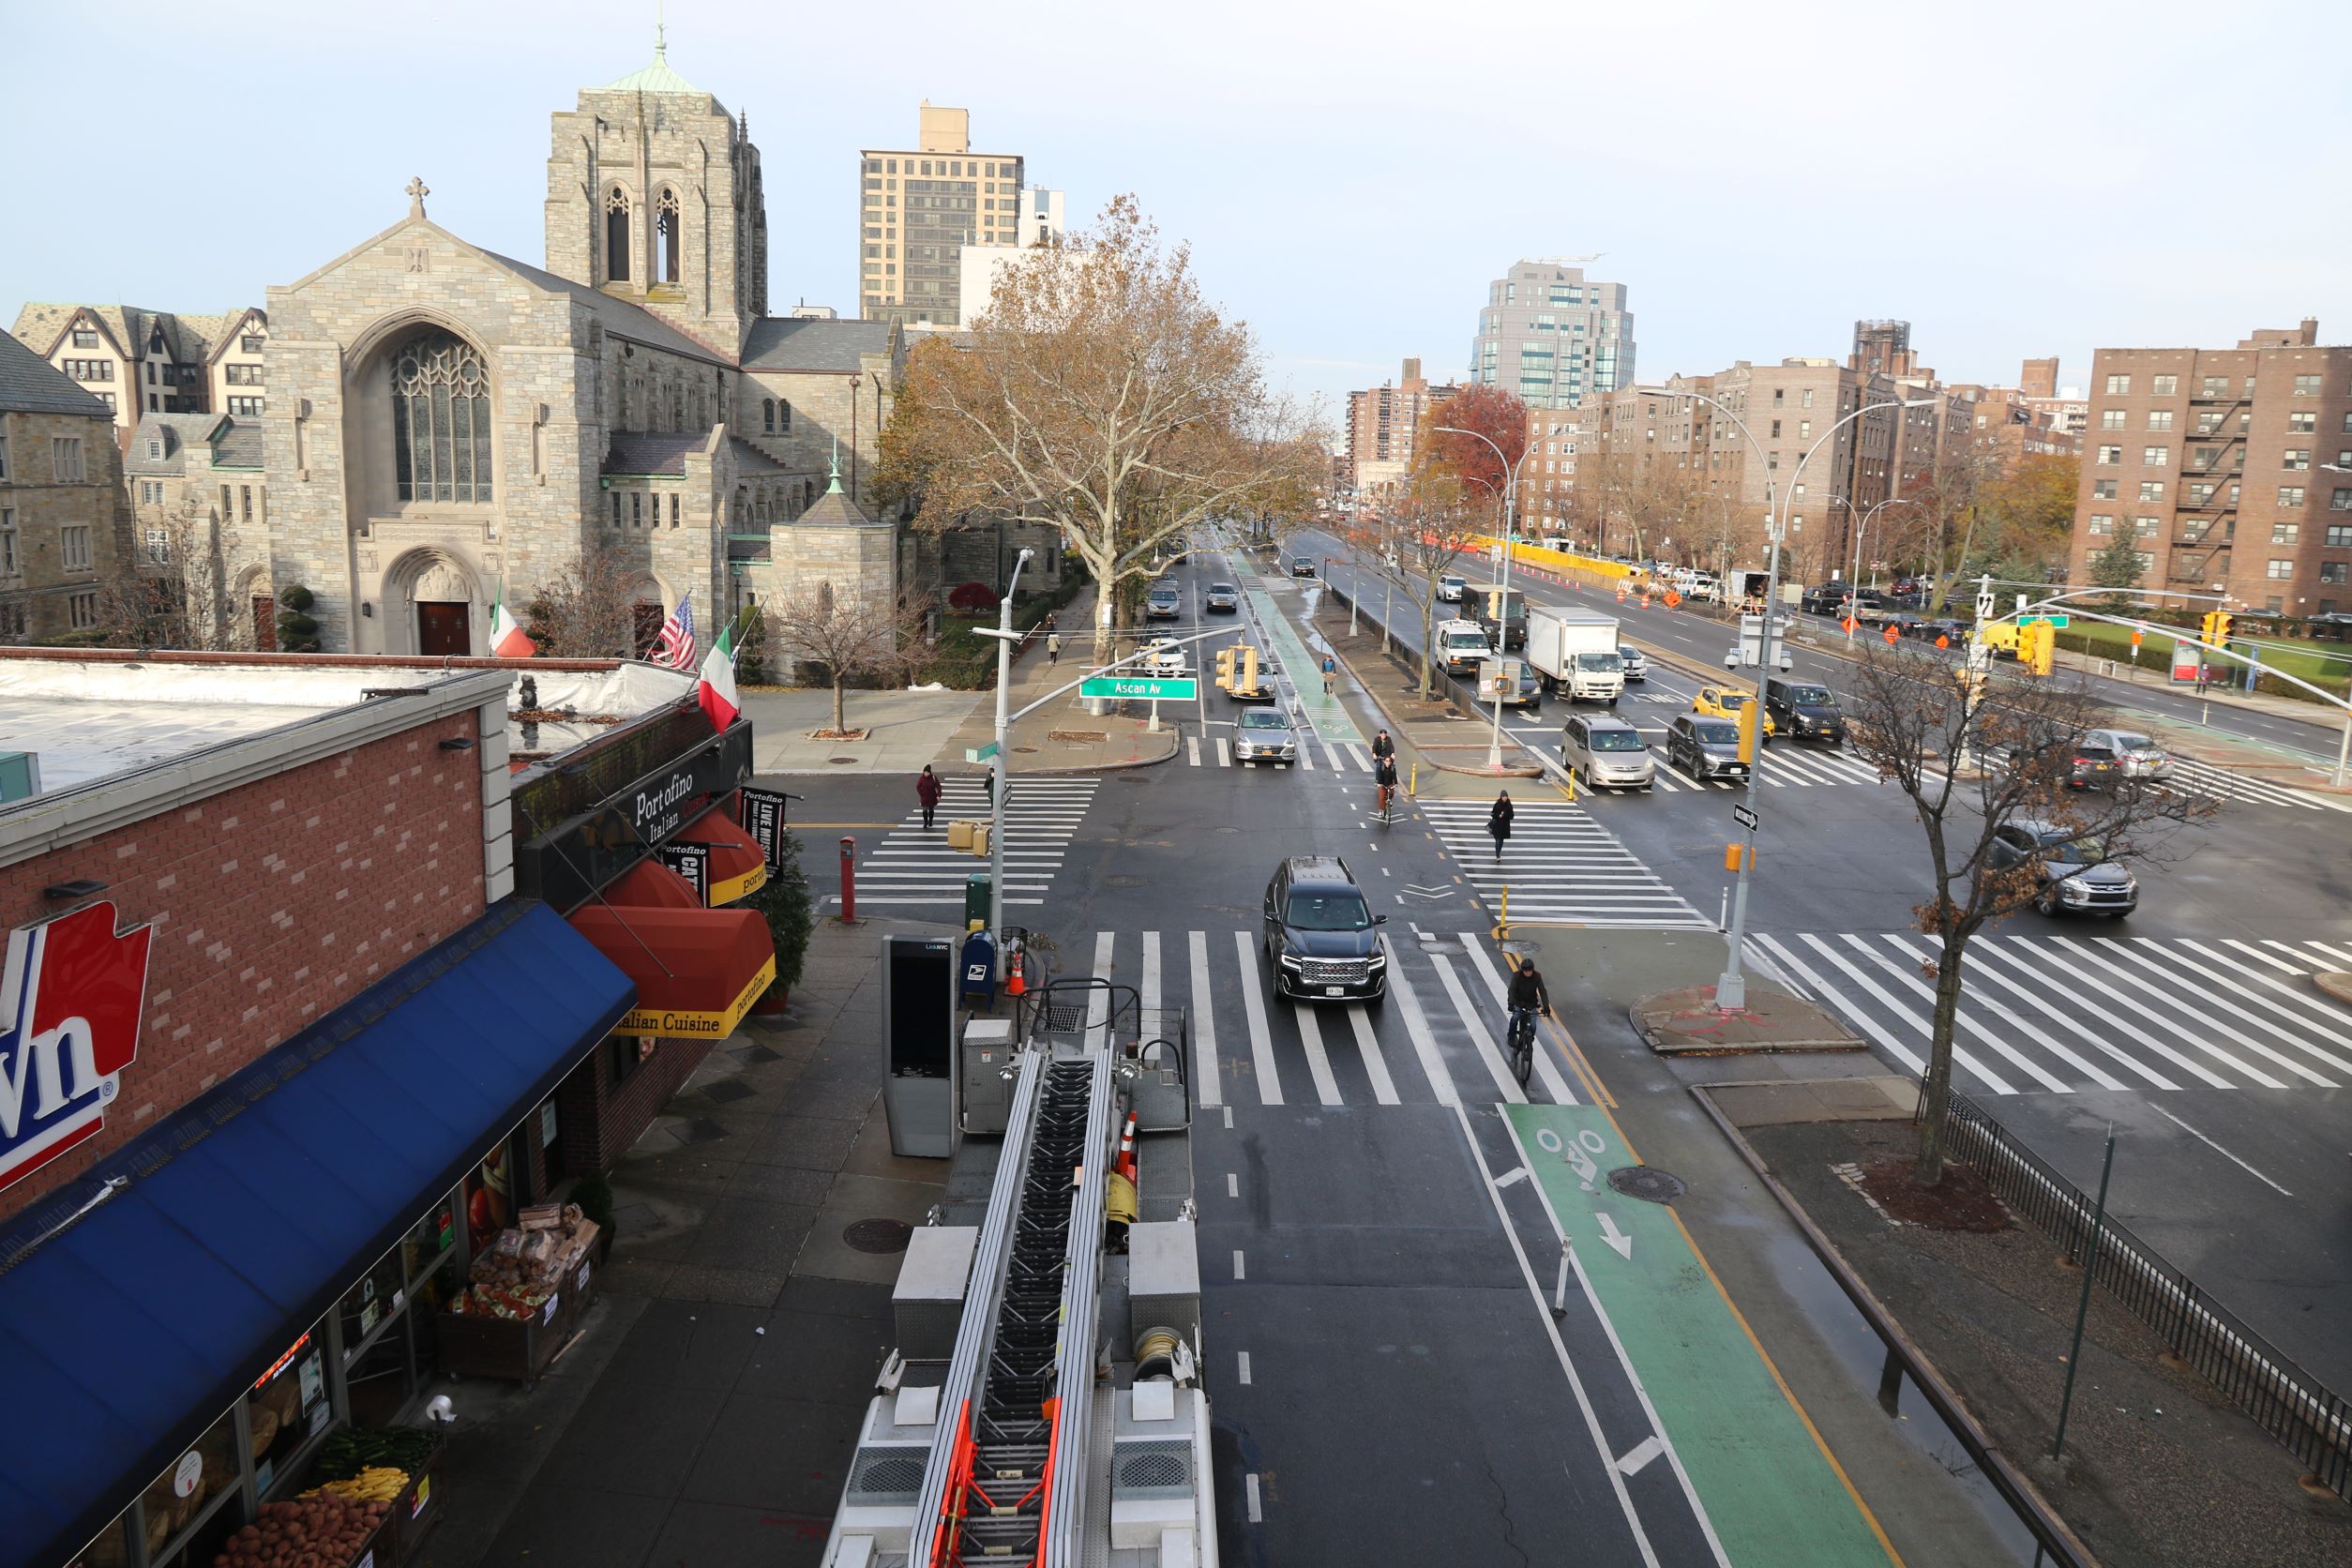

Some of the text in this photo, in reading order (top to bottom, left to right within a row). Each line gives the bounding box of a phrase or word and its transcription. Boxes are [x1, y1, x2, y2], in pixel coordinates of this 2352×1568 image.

[1115, 682, 1162, 694] Ascan Av
[637, 774, 693, 826] Portofino
[744, 791, 783, 804] Portofino
[760, 803, 773, 827] LIVE
[650, 812, 679, 843] Italian
[736, 973, 765, 1020] portofino
[663, 1013, 719, 1032] Cuisine
